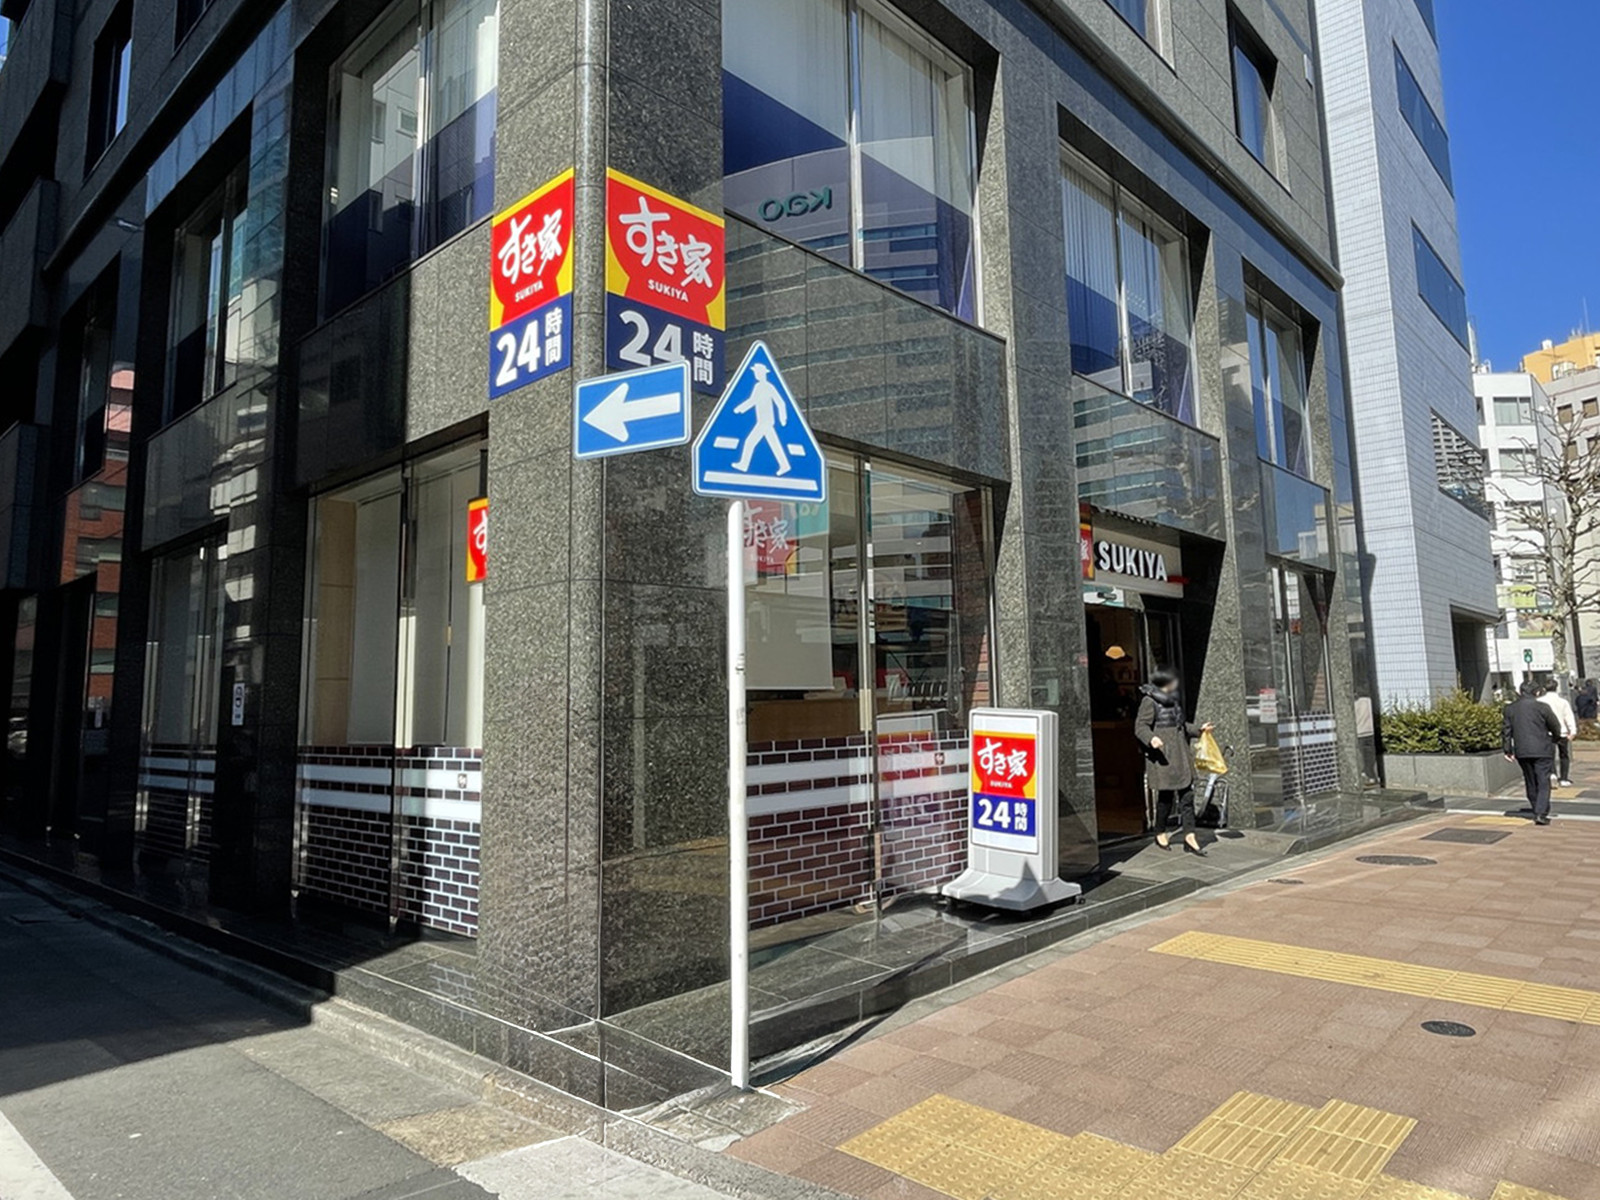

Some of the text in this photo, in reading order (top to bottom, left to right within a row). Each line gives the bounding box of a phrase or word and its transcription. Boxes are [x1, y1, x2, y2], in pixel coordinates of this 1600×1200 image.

[498, 209, 562, 284] すき家
[619, 196, 713, 288] すき家
[515, 280, 544, 302] SUKIYA
[648, 279, 689, 302] SUKIYA
[1098, 540, 1168, 581] SUKIYA
[977, 738, 1028, 780] すき家
